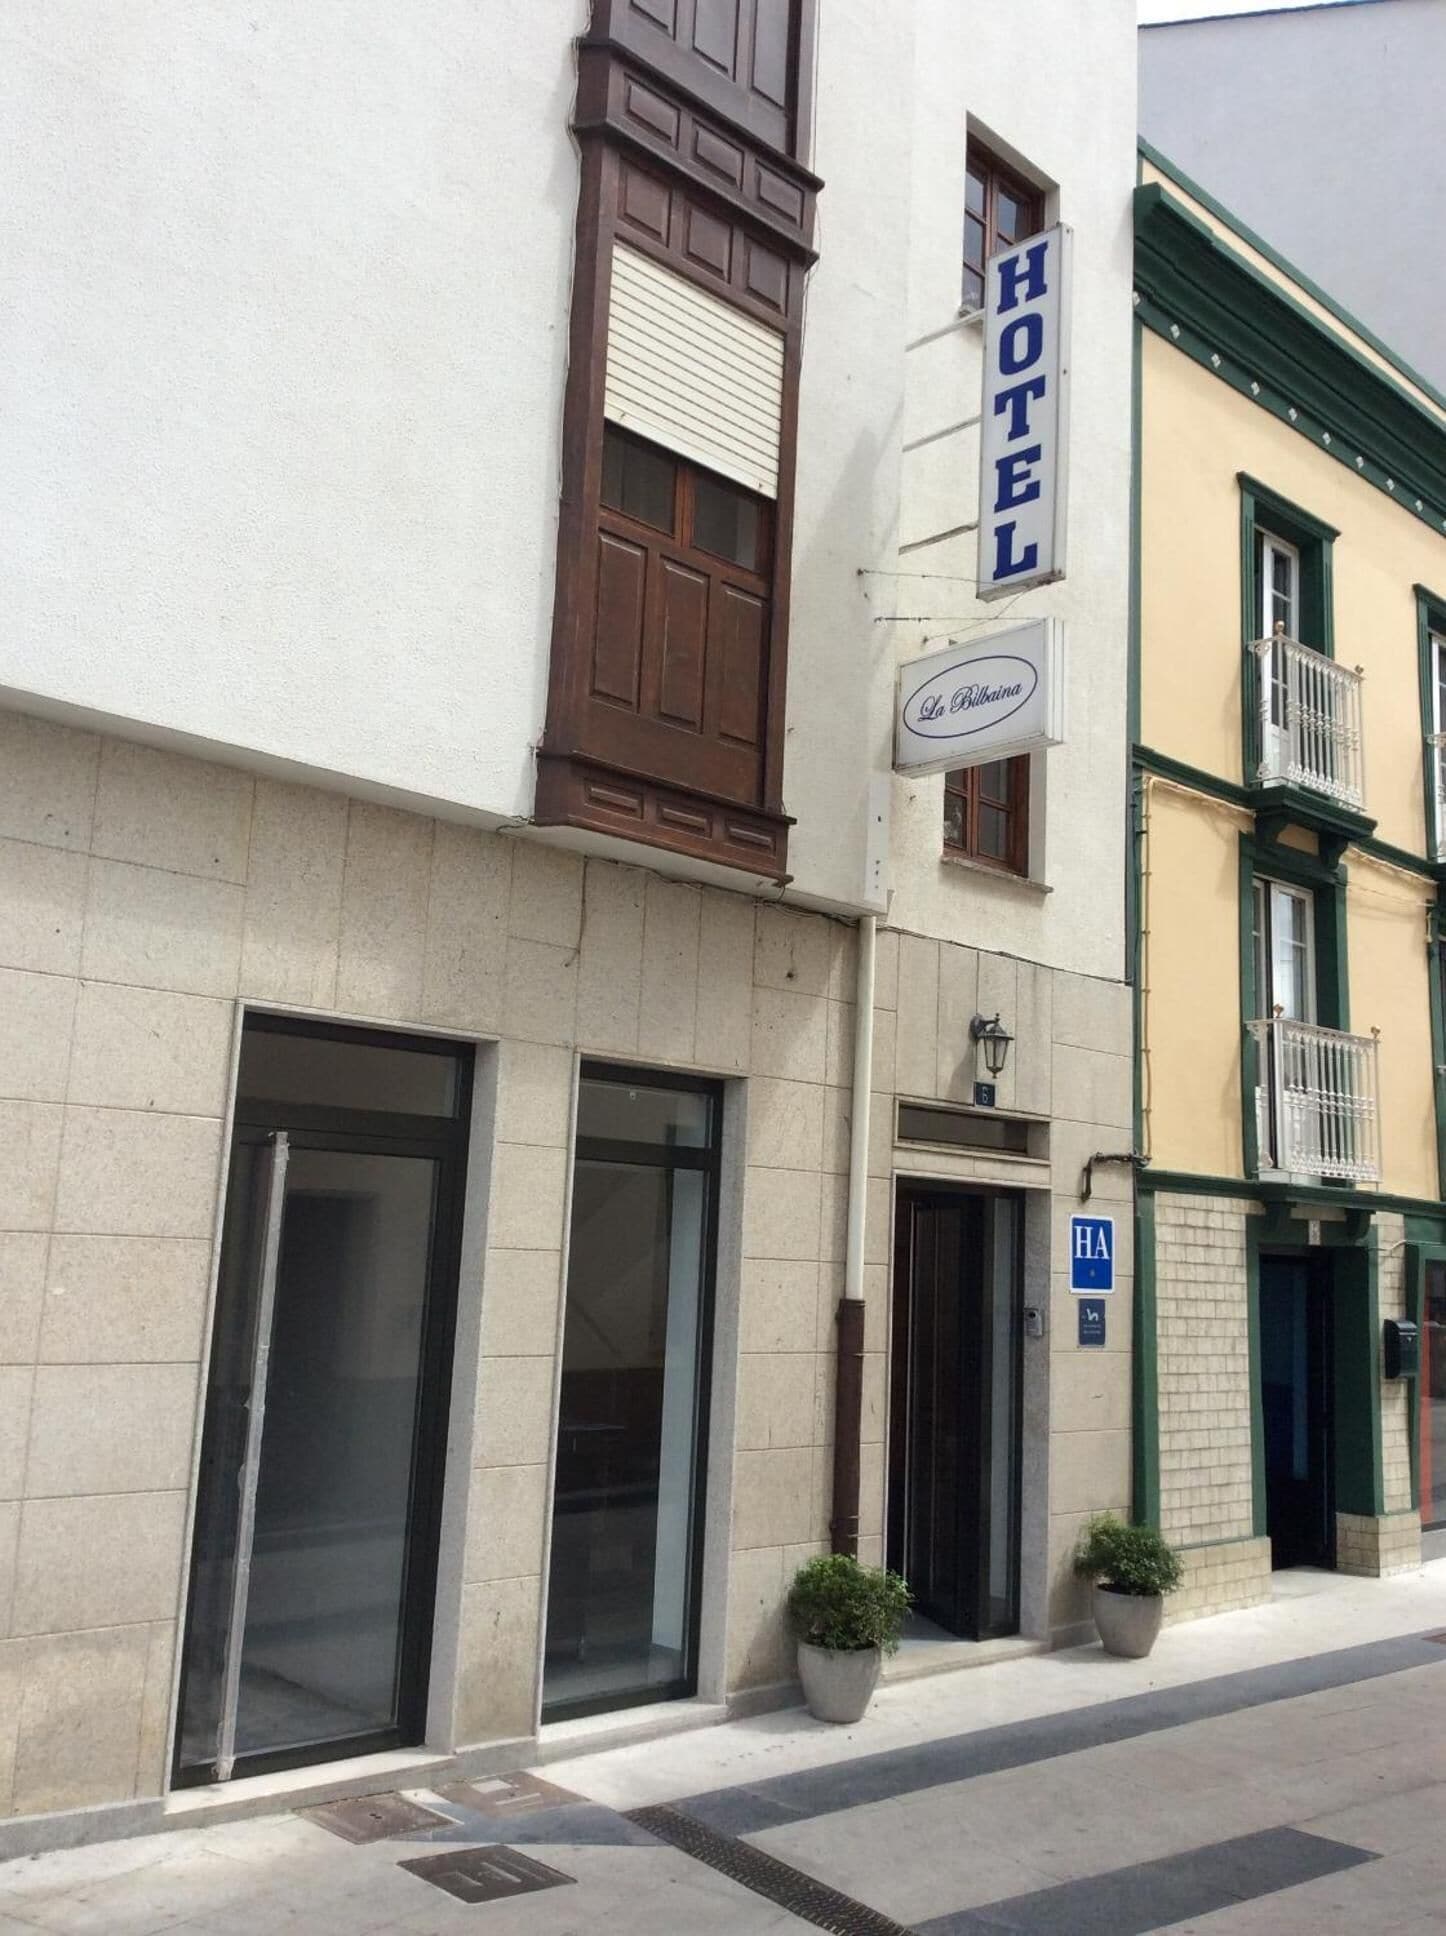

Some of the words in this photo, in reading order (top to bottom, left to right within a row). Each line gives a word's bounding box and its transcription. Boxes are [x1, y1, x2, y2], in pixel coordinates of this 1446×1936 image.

[992, 241, 1049, 581] HOTEL
[918, 694, 945, 722] La
[950, 683, 1022, 714] Bilbaina
[1073, 1225, 1110, 1260] HA
